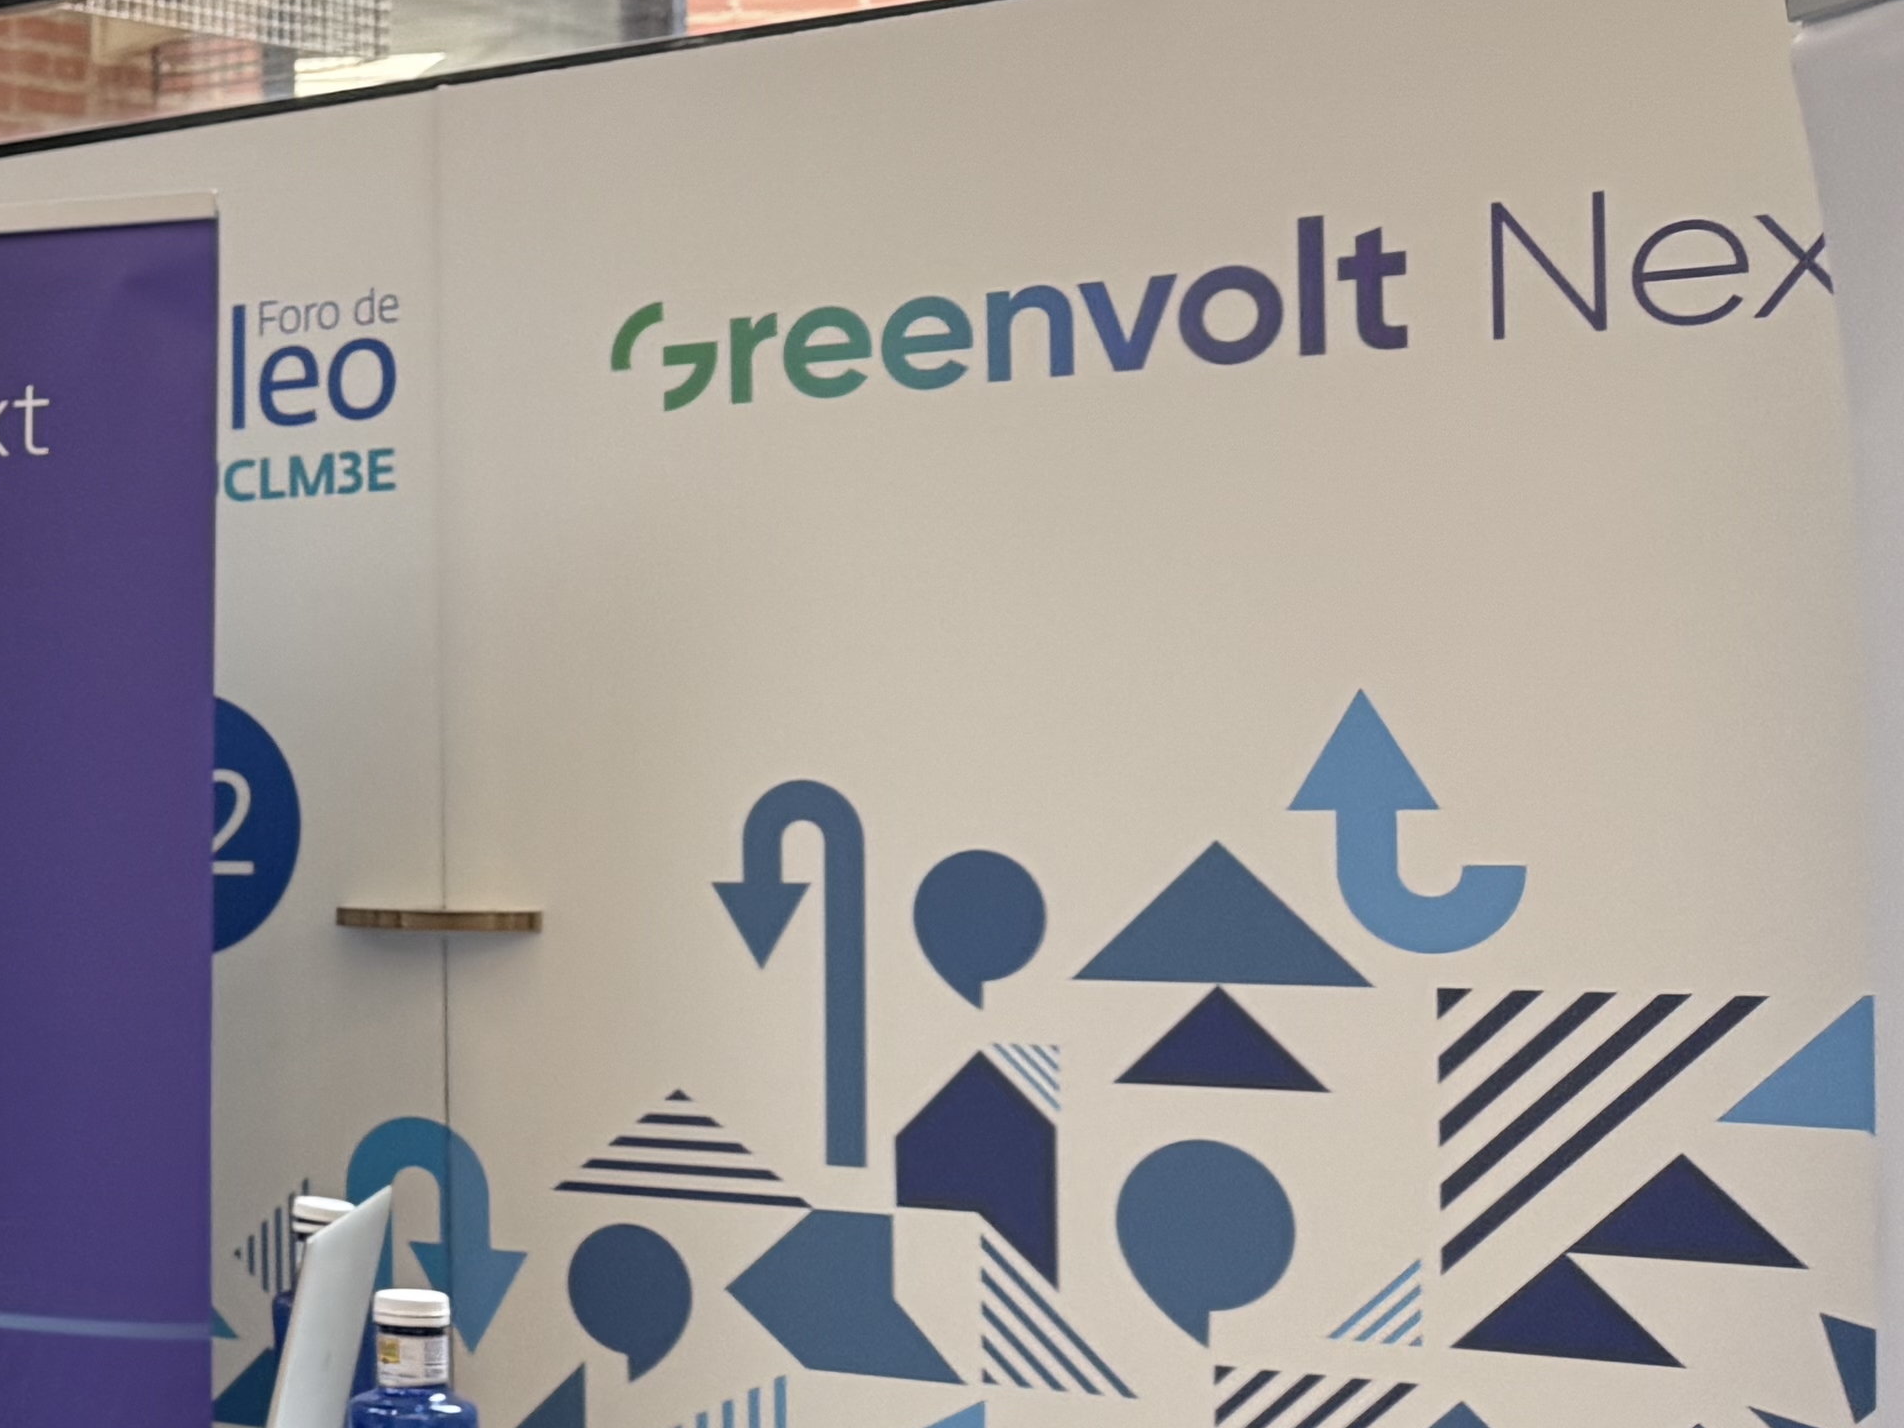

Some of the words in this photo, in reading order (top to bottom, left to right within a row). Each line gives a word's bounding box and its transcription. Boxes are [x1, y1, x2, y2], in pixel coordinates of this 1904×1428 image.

[258, 300, 340, 336] Foro
[354, 287, 399, 325] de
[610, 215, 1409, 412] Greenvolt
[1491, 190, 1835, 340] Nex
[232, 303, 396, 430] leo
[223, 448, 396, 502] CLM3E
[212, 768, 255, 876] 2
